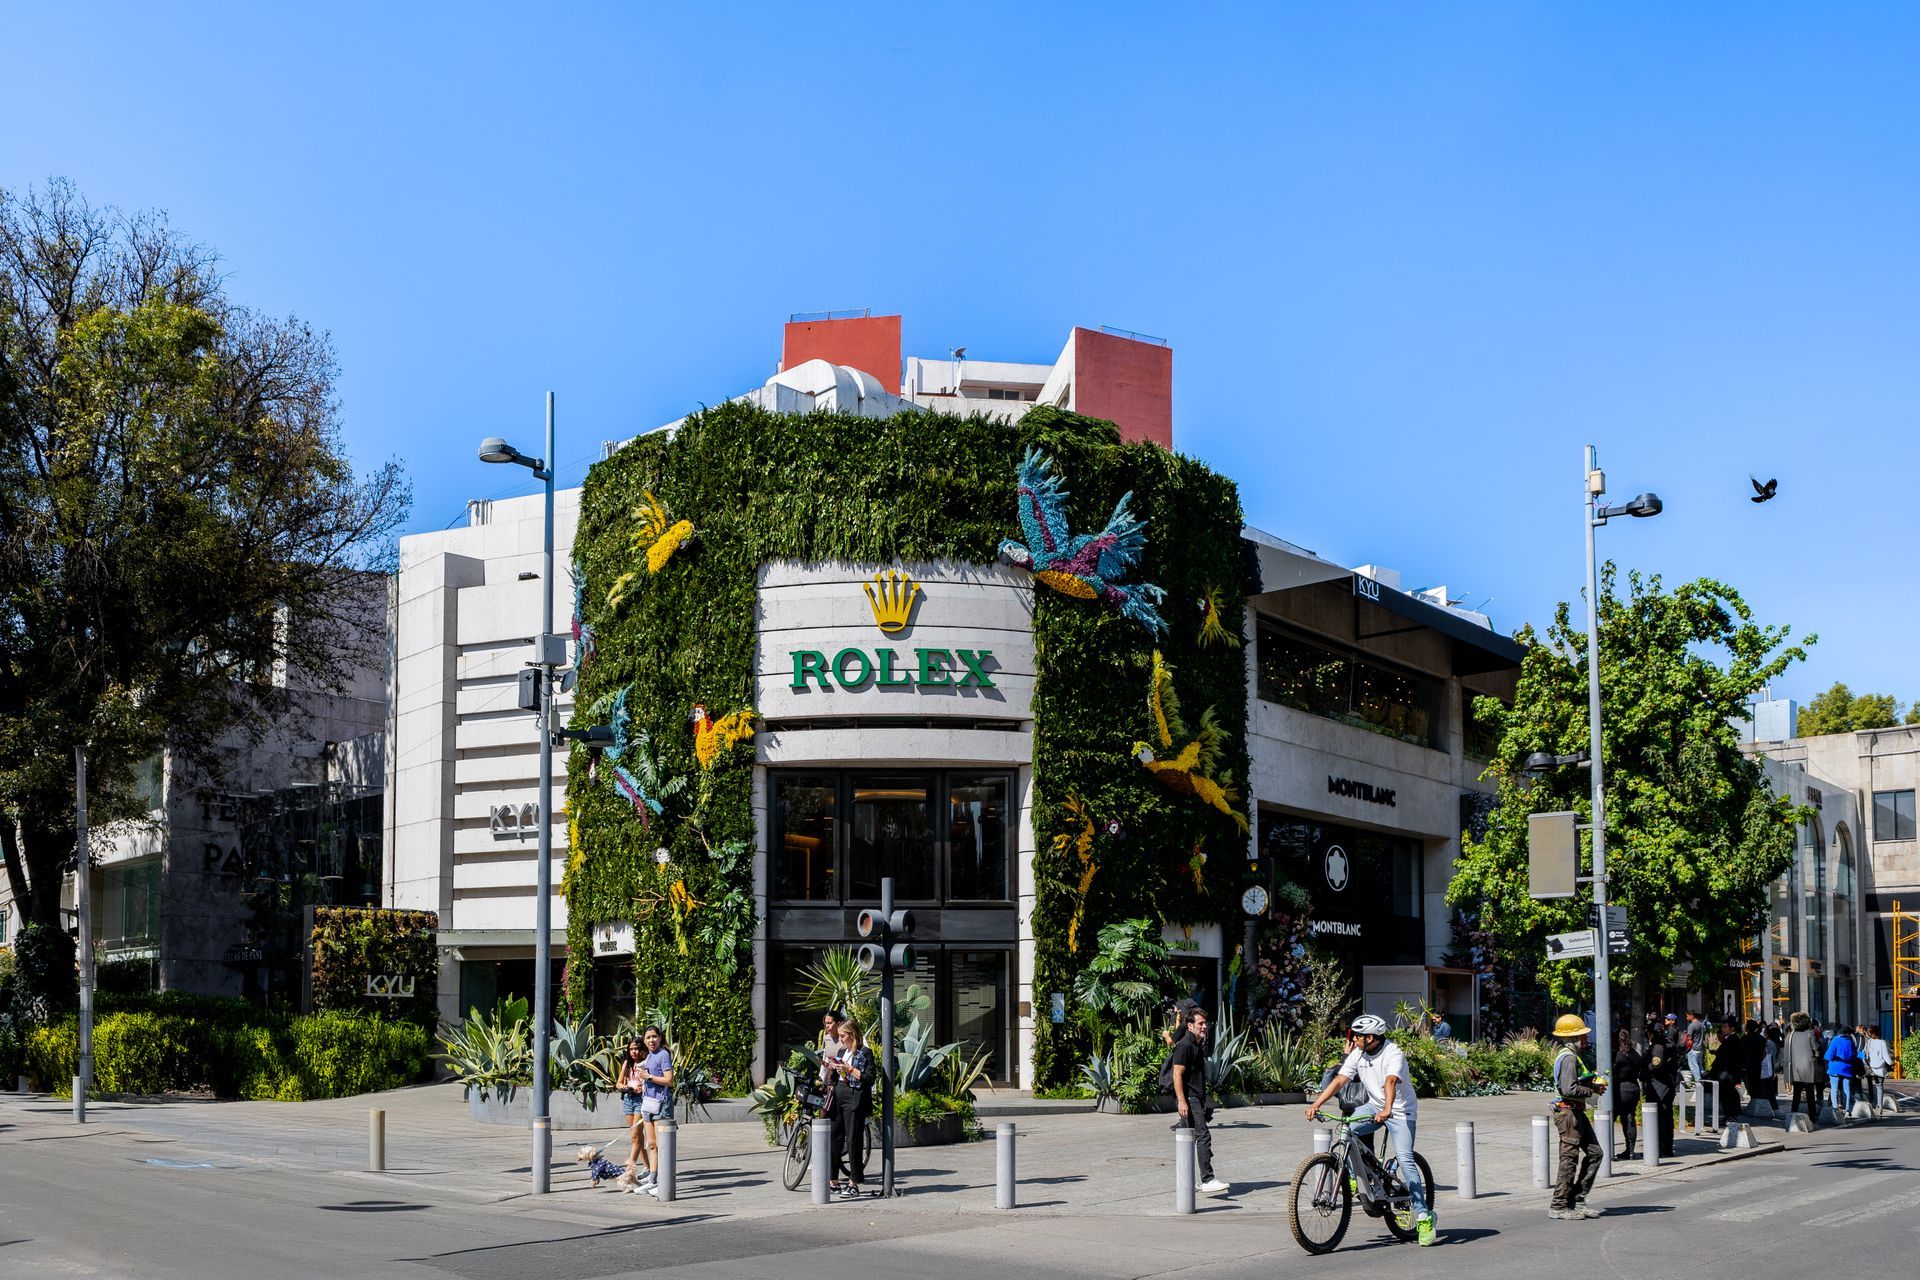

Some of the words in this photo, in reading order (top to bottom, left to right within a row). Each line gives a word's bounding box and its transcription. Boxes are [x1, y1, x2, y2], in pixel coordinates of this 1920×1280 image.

[1358, 575, 1379, 599] KYU
[789, 647, 997, 688] ROLEX
[1327, 775, 1396, 808] MONTBLANC
[1312, 920, 1361, 937] MONTBLANC
[366, 974, 415, 999] KYU
